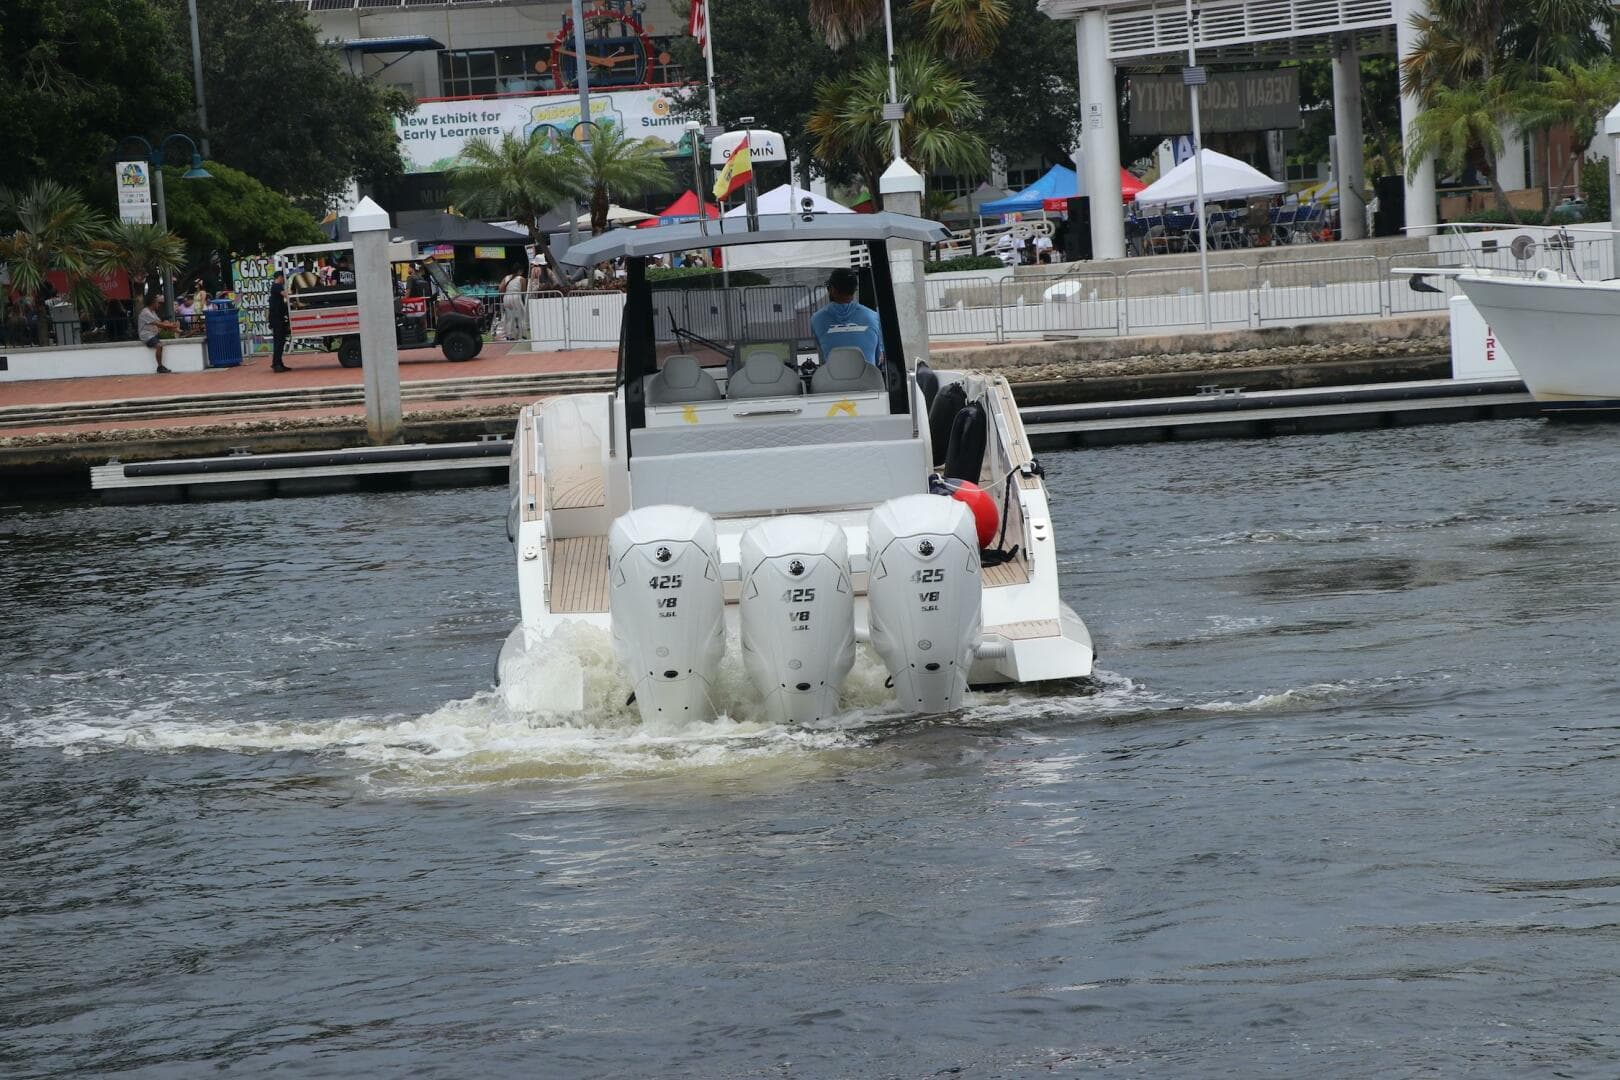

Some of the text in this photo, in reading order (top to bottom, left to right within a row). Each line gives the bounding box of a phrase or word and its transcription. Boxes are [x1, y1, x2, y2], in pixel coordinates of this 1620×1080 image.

[400, 111, 501, 127] New Exhibit for
[403, 126, 500, 140] Early Learners
[722, 147, 774, 158] GMIN
[240, 260, 268, 278] EAT
[248, 310, 267, 322] THE
[1486, 326, 1496, 361] IRE
[648, 574, 683, 590] 425
[910, 568, 945, 583] 425
[781, 588, 816, 603] 425
[919, 591, 940, 602] V8
[657, 597, 678, 609] V8
[789, 611, 810, 622] V8
